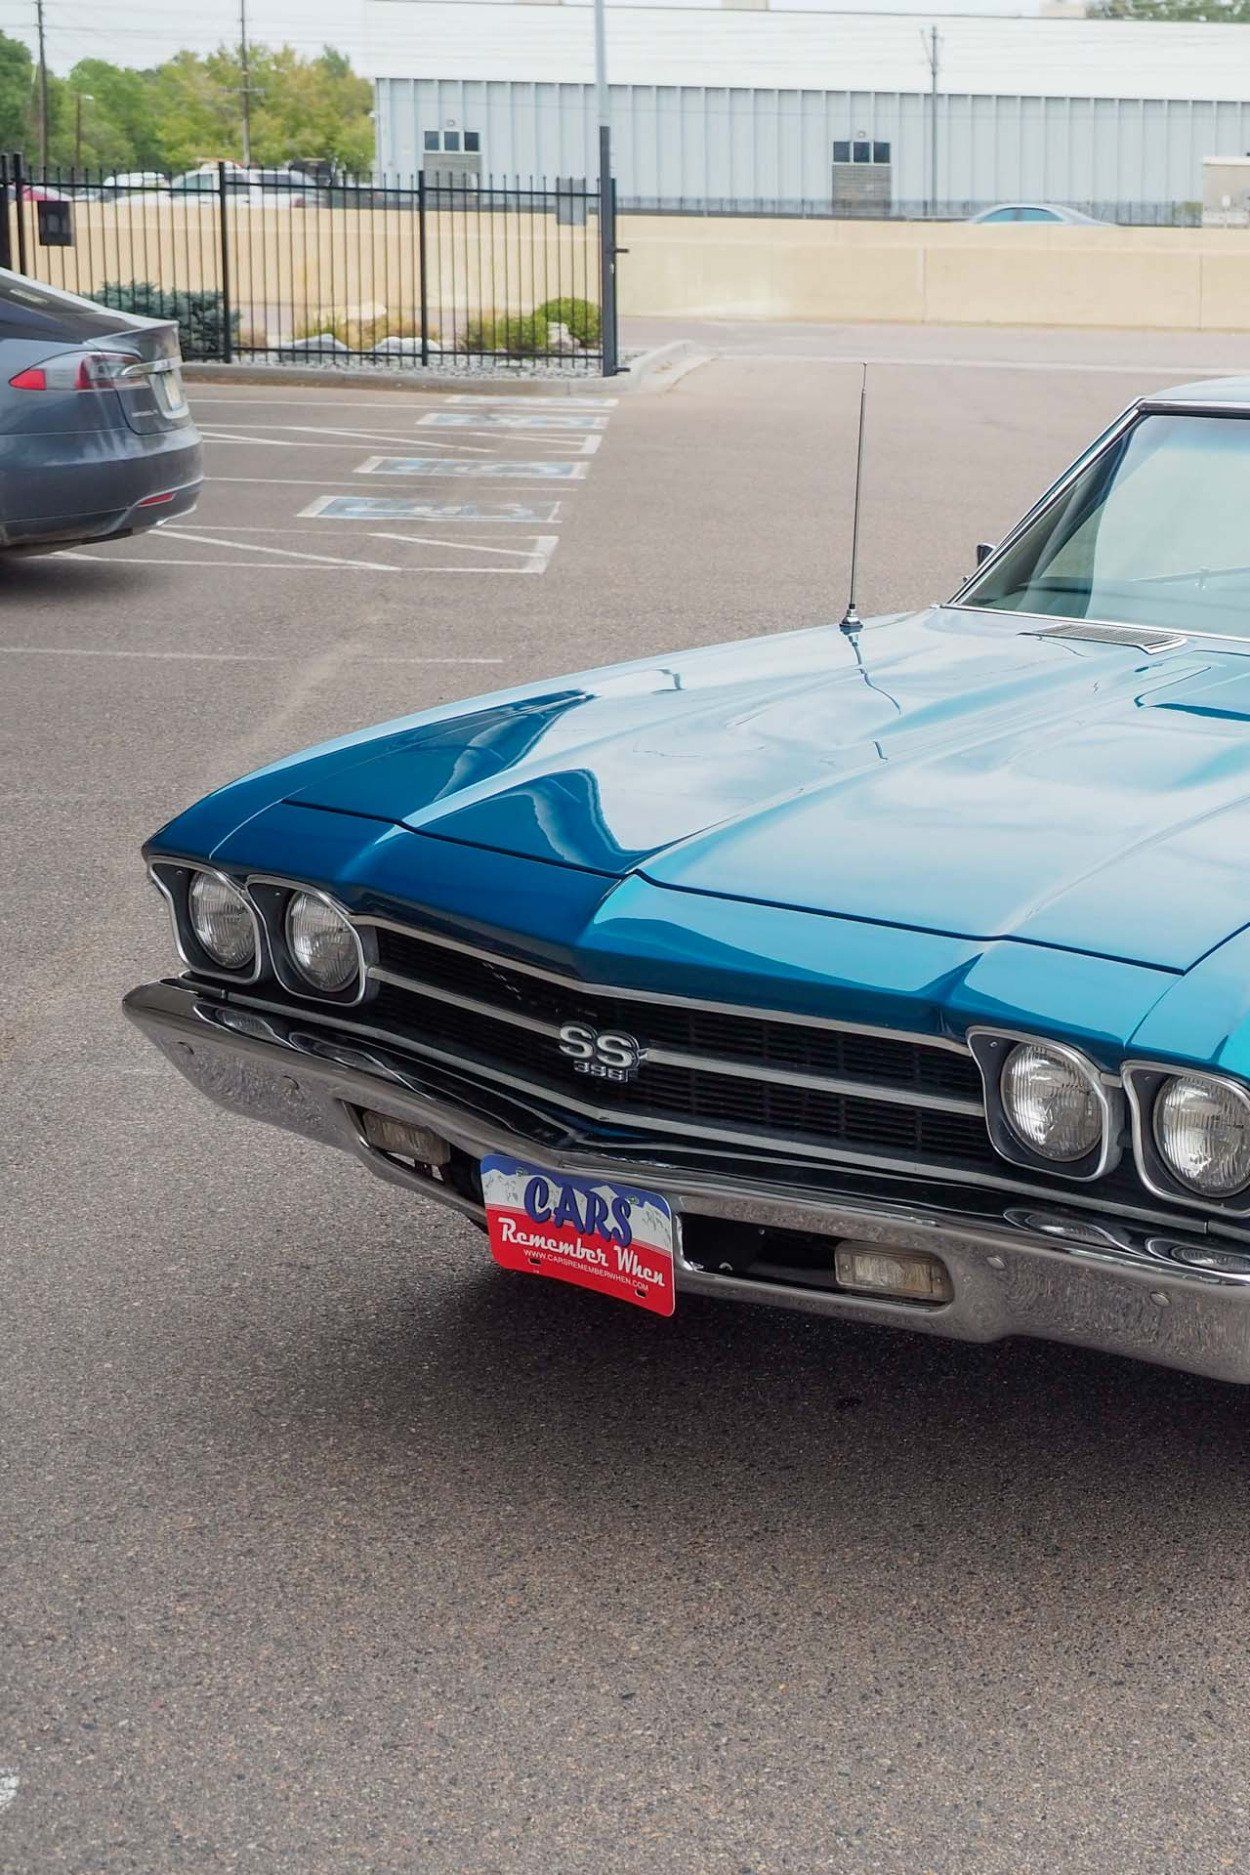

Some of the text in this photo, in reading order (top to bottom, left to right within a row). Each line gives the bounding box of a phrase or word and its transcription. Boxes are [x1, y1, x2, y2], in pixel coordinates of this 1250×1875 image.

[558, 1024, 635, 1068] SS
[524, 1176, 633, 1248] CARS
[498, 1217, 665, 1287] Remember When
